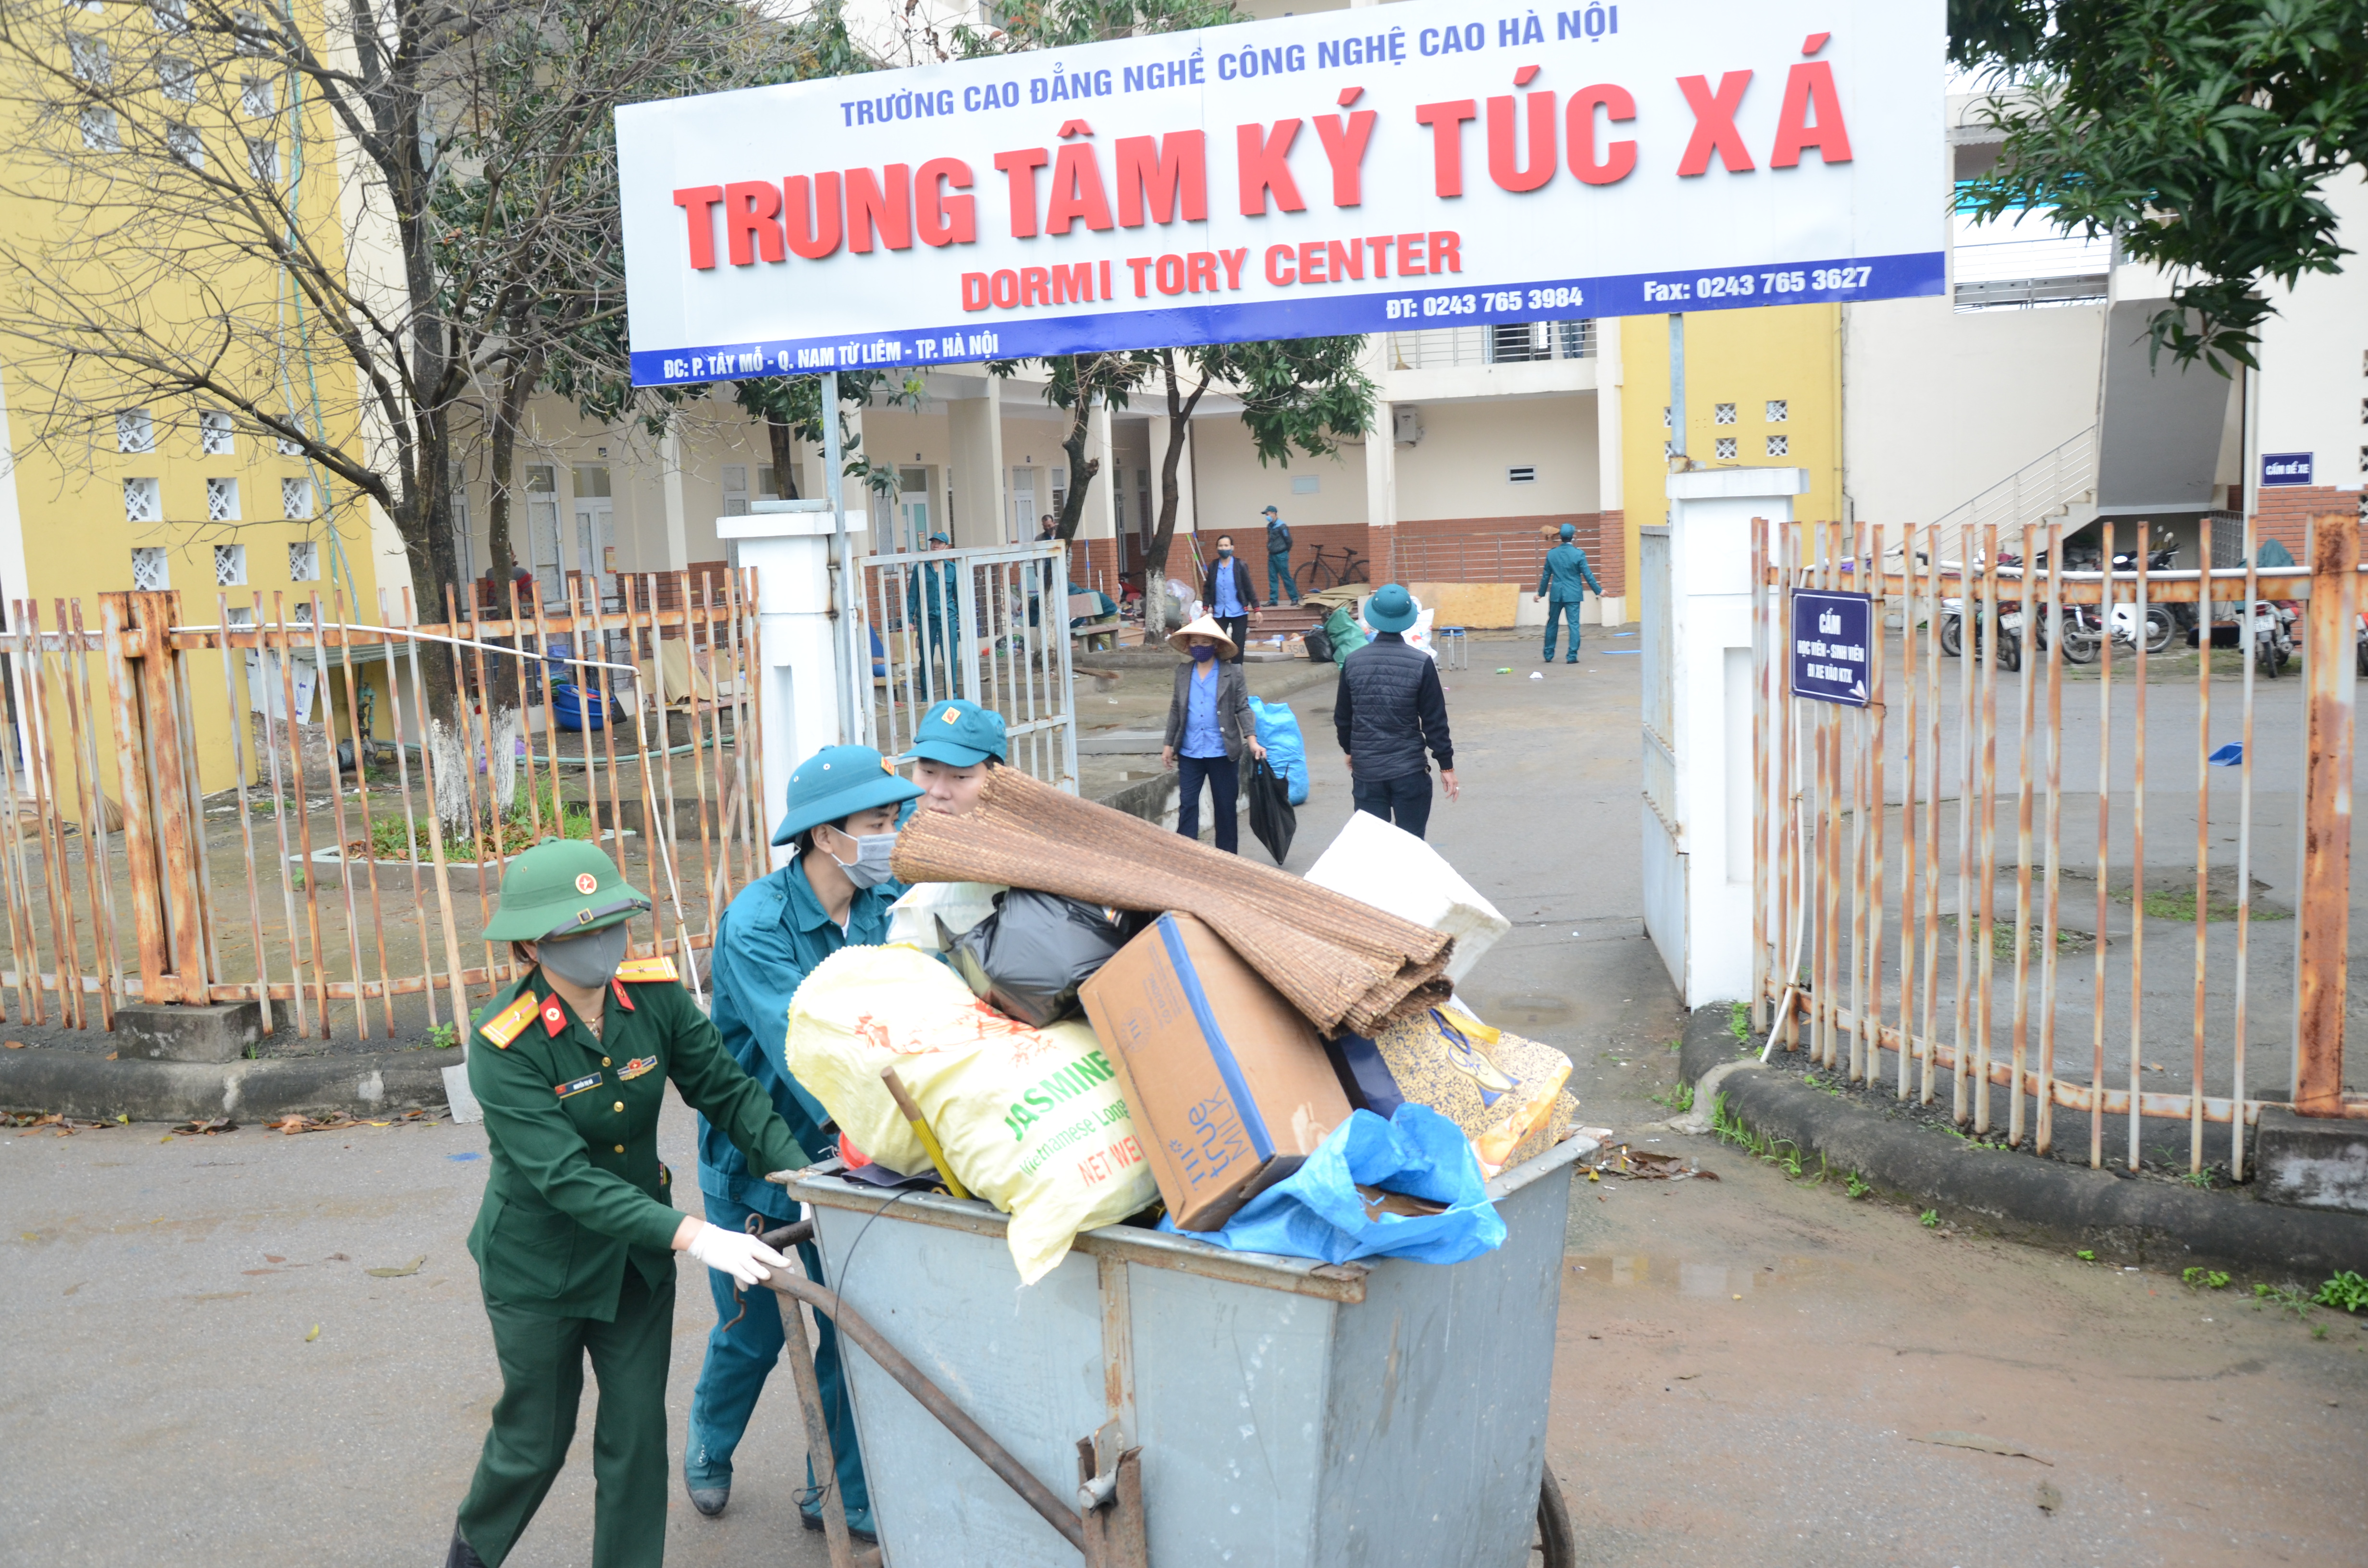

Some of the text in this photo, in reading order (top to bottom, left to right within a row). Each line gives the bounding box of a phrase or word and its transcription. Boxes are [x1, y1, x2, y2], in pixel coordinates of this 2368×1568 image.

[840, 1, 1617, 127] TRƯỜNG CAO ĐẲNG NGHỀ CÔNG NGHỆ CAO HÀ NỘI
[673, 32, 1853, 269] TRUNG TÂM KÝ TÚC XÁ
[1265, 231, 1461, 285] CENTER
[1644, 267, 1872, 301] Fax: 0243 765 3627
[1386, 287, 1583, 318] ĐT: 0243 765 3984
[664, 359, 689, 378] ĐC:
[692, 357, 704, 376] P.
[707, 352, 735, 375] TÂY
[739, 345, 764, 372] MỖ
[777, 350, 793, 371] Q.
[798, 347, 835, 368] NAM
[838, 341, 861, 365] TỪ
[863, 339, 901, 363] LIÊM
[916, 339, 938, 359] TP.
[942, 332, 965, 357] HÀ
[969, 330, 999, 358] NỘI
[1004, 1050, 1115, 1142] JASMINE
[1204, 1085, 1249, 1161] MILK
[1019, 1099, 1131, 1177] Vietnamese Long
[1077, 1151, 1112, 1187] NET
[1189, 1102, 1230, 1178] true
